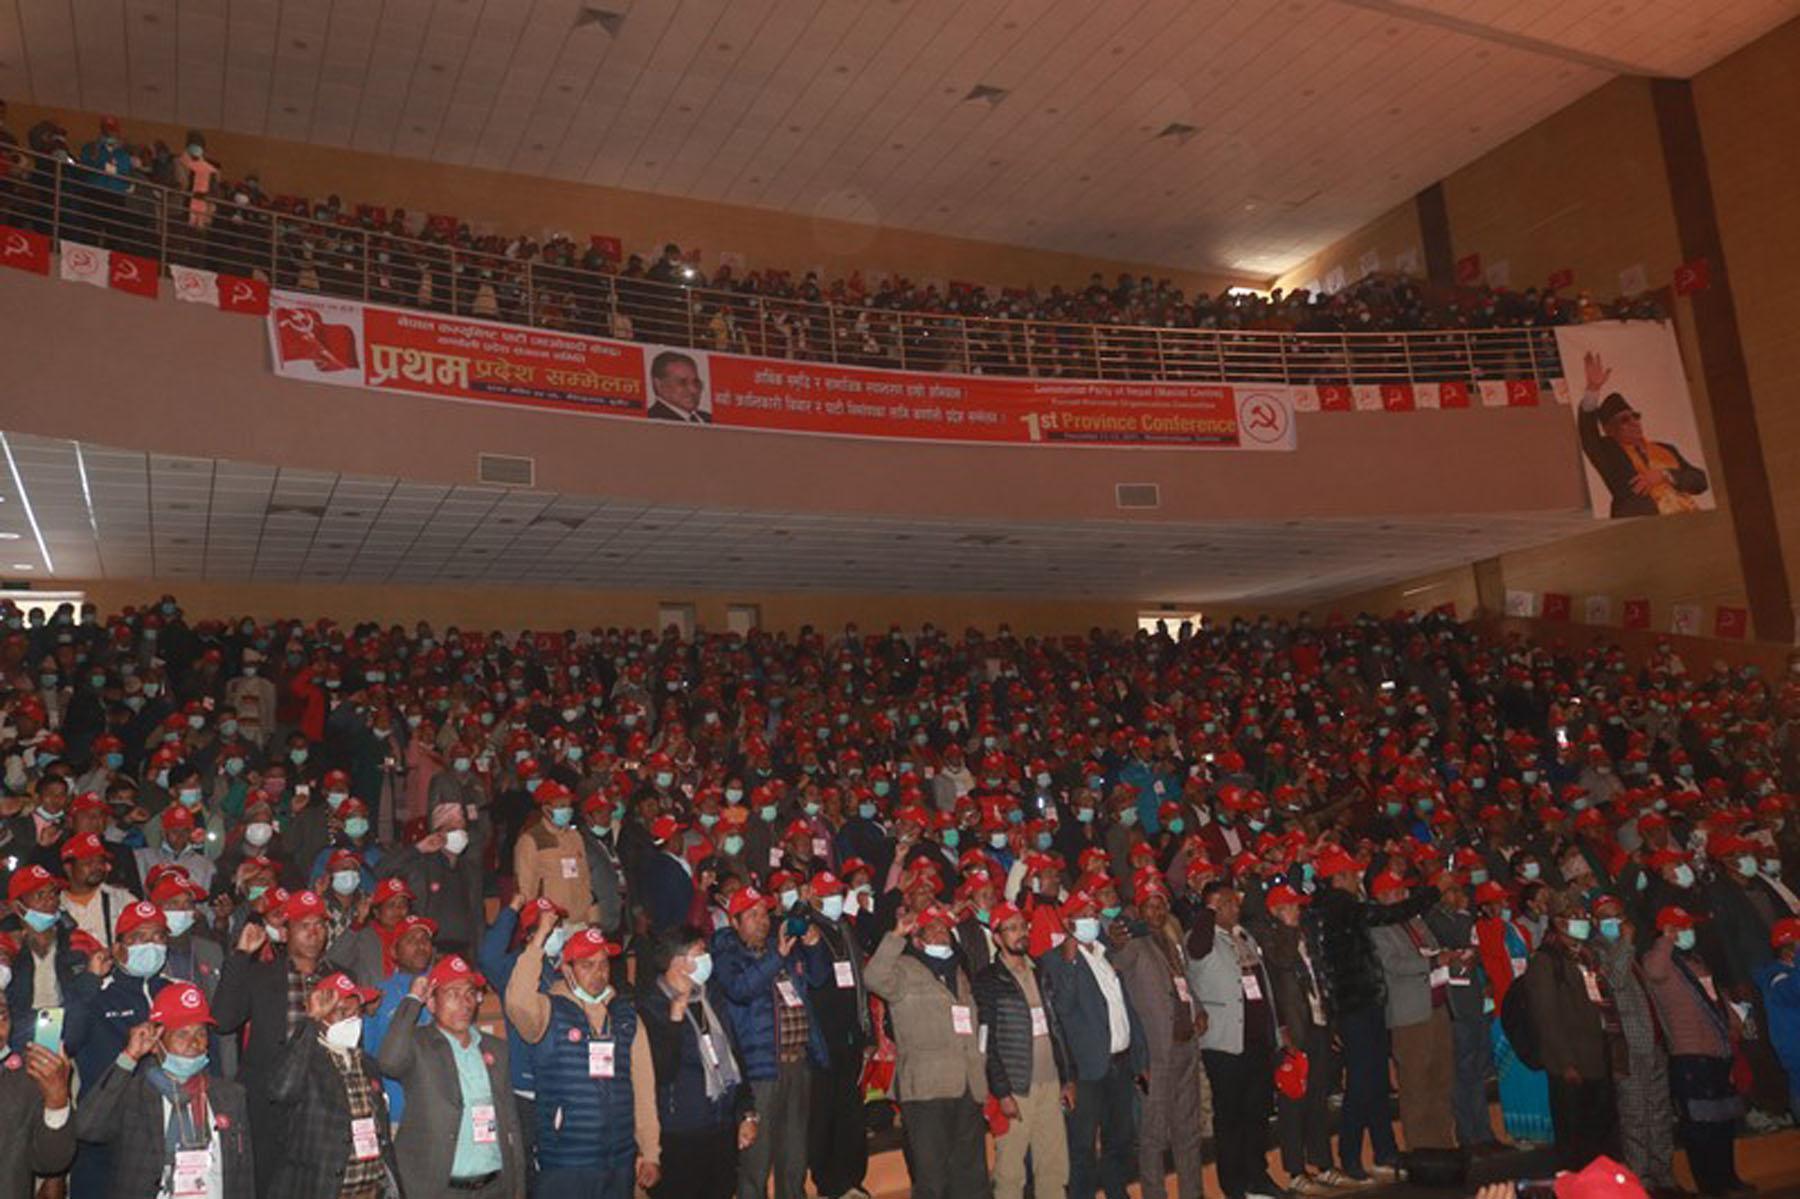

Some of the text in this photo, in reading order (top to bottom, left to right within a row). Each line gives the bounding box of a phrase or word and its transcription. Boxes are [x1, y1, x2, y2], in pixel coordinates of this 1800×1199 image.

[368, 343, 641, 395] प्रथम प्रदेश सम्मेलन
[1019, 411, 1059, 441] 1st
[1061, 412, 1137, 431] Province
[1141, 414, 1237, 432] Conference
